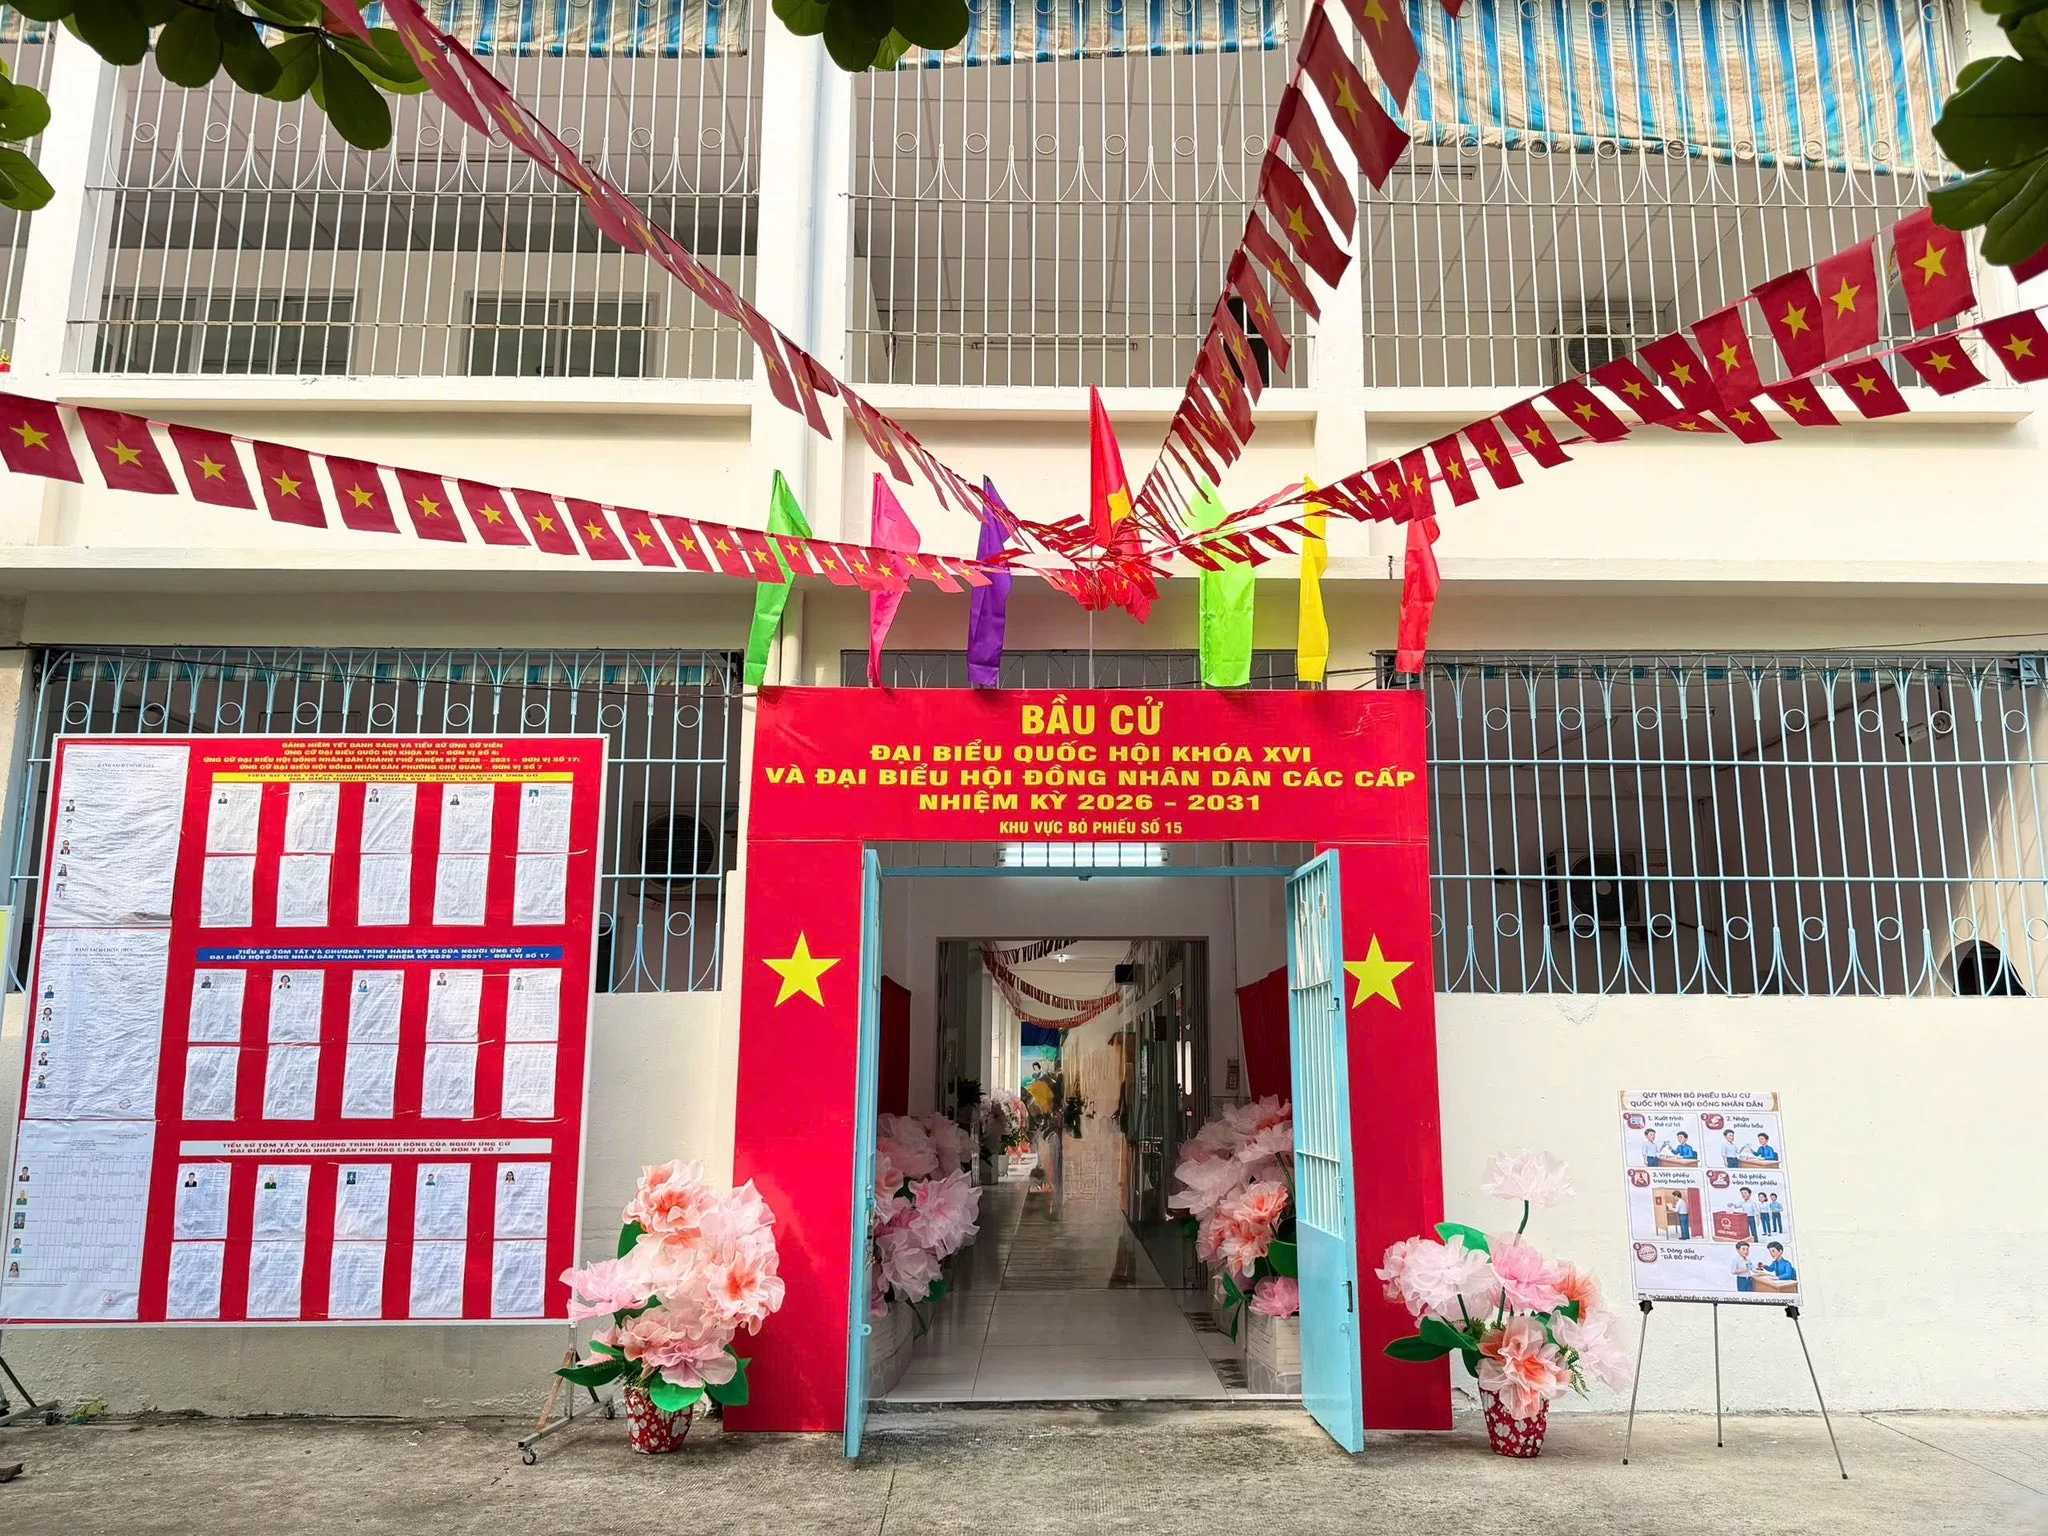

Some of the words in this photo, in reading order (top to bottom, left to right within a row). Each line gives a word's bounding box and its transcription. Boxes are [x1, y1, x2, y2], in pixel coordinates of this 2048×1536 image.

[1021, 694, 1095, 735] BẦU
[1111, 696, 1164, 735] CỬ
[870, 744, 921, 764] ĐẠI
[932, 739, 1002, 762] BIỂU
[1013, 740, 1096, 762] QUỐC
[1109, 742, 1160, 765] HỘI
[1172, 743, 1252, 762] KHÓA
[1262, 746, 1311, 762] XVI
[765, 764, 805, 784] VÀ
[815, 768, 867, 788] ĐẠI
[878, 764, 948, 786] BIỂU
[960, 766, 1012, 788] HỘI
[1023, 764, 1106, 786] ĐỒNG
[1118, 766, 1199, 786] NHÂN
[1212, 766, 1278, 786] DÂN
[1282, 766, 1343, 786] CÁC
[1355, 765, 1416, 786] CẤP
[919, 790, 1018, 813] NHIỆM
[1030, 790, 1068, 810] KỲ
[1077, 794, 1153, 810] 2026
[1188, 794, 1260, 810] 2031
[1000, 822, 1028, 834] KHU
[1034, 820, 1062, 835] VỰC
[1068, 818, 1087, 834] BỎ
[1092, 818, 1136, 834] PHIẾU
[1141, 818, 1161, 834] SỐ
[1165, 822, 1183, 834] 15
